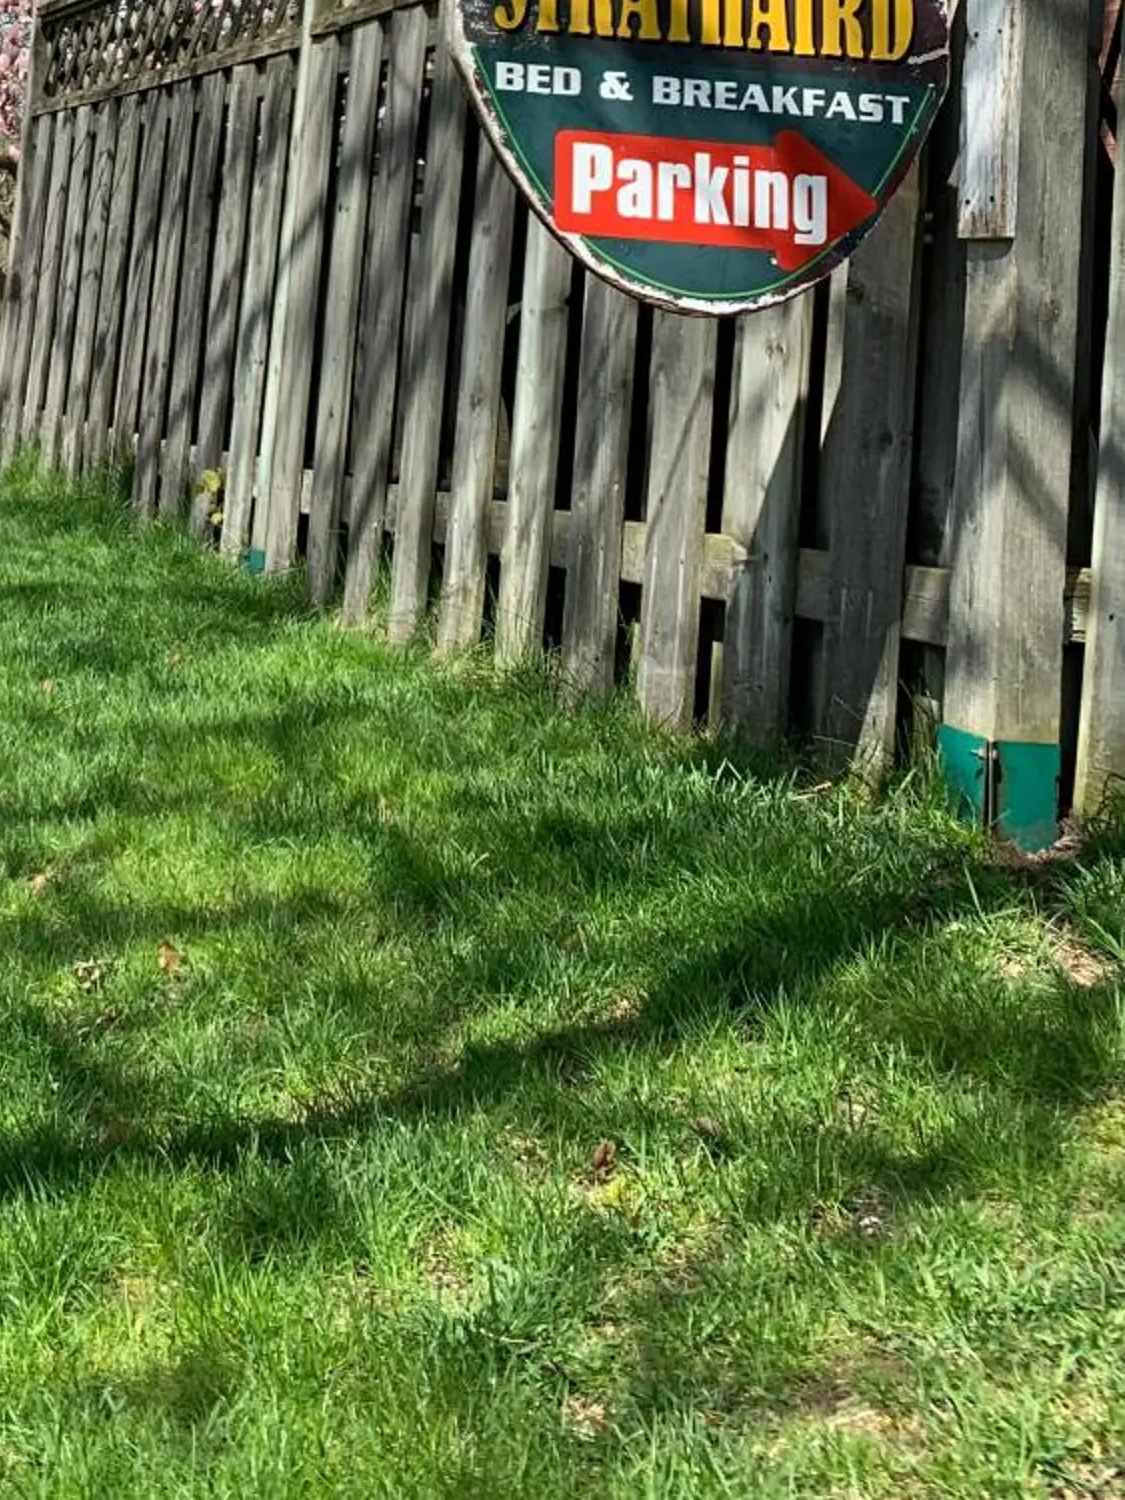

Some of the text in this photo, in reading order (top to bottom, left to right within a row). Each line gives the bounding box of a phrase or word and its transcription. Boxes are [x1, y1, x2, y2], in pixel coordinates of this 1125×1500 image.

[495, 61, 910, 125] BED & BREAKFAST
[571, 141, 828, 245] Parking
